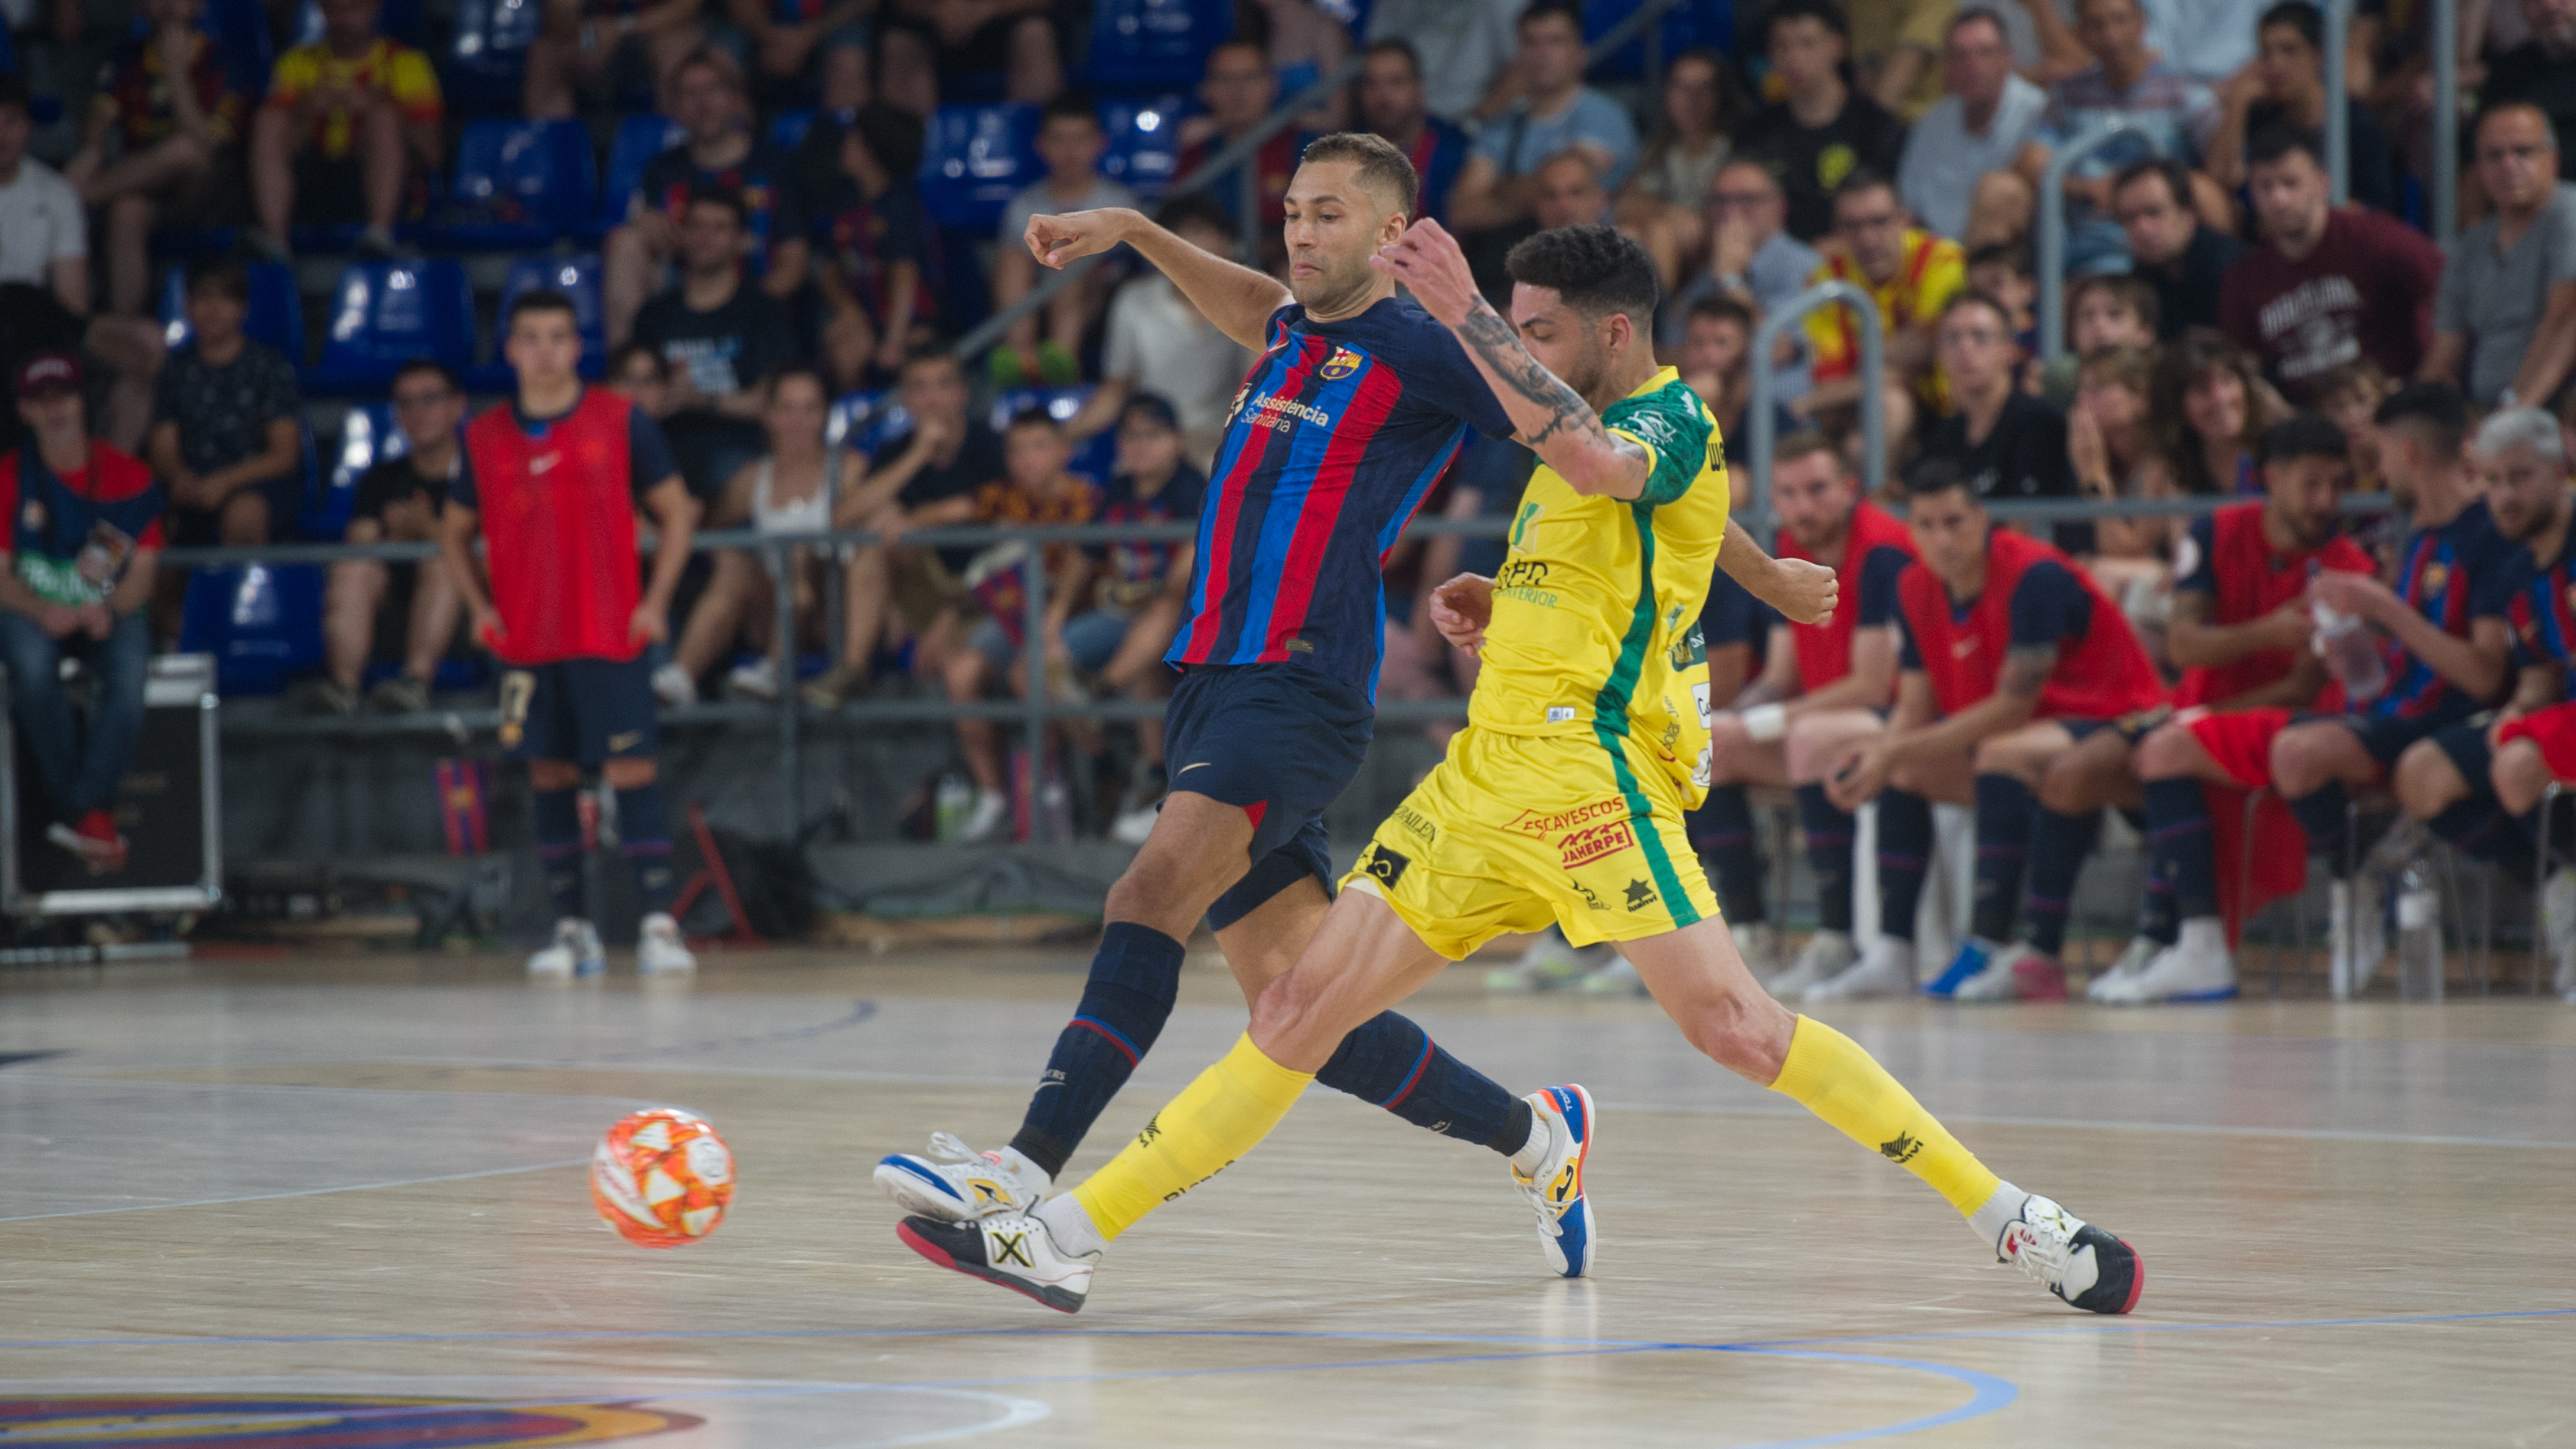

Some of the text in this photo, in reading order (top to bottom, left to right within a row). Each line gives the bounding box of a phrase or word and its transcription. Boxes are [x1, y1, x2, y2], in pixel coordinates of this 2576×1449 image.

[1240, 407, 1291, 433] Sanitària
[1251, 391, 1329, 427] Assistència
[1523, 796, 1624, 831] ESCAYESCOS
[1562, 832, 1626, 863] JAHERPE
